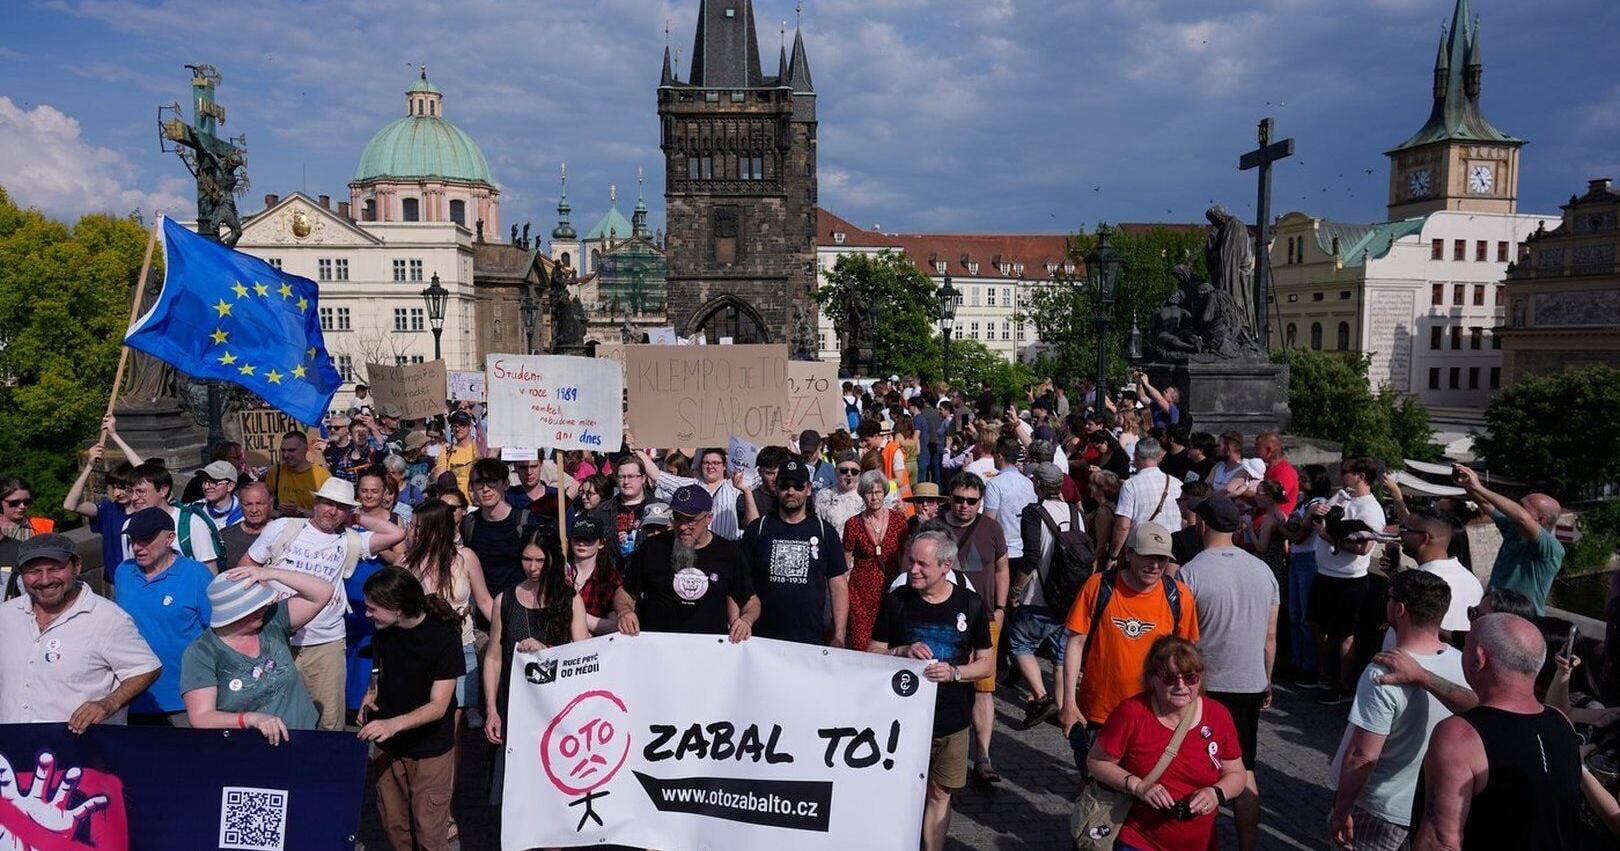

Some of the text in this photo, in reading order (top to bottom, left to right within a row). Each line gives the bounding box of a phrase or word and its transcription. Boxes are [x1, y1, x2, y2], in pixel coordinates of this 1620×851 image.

[493, 360, 542, 381] Studenti
[738, 366, 752, 389] JE
[757, 355, 787, 388] TO
[805, 374, 829, 392] to
[529, 388, 548, 398] roce
[556, 387, 578, 401] 1989
[241, 412, 298, 434] KULTURA
[555, 429, 602, 446] ani dnes
[563, 652, 599, 668] RUCE PRYČ
[561, 668, 573, 679] OD
[559, 718, 615, 758] OTO
[643, 719, 901, 771] ZABAL TO!
[661, 787, 819, 817] www.otozabalto.cz
